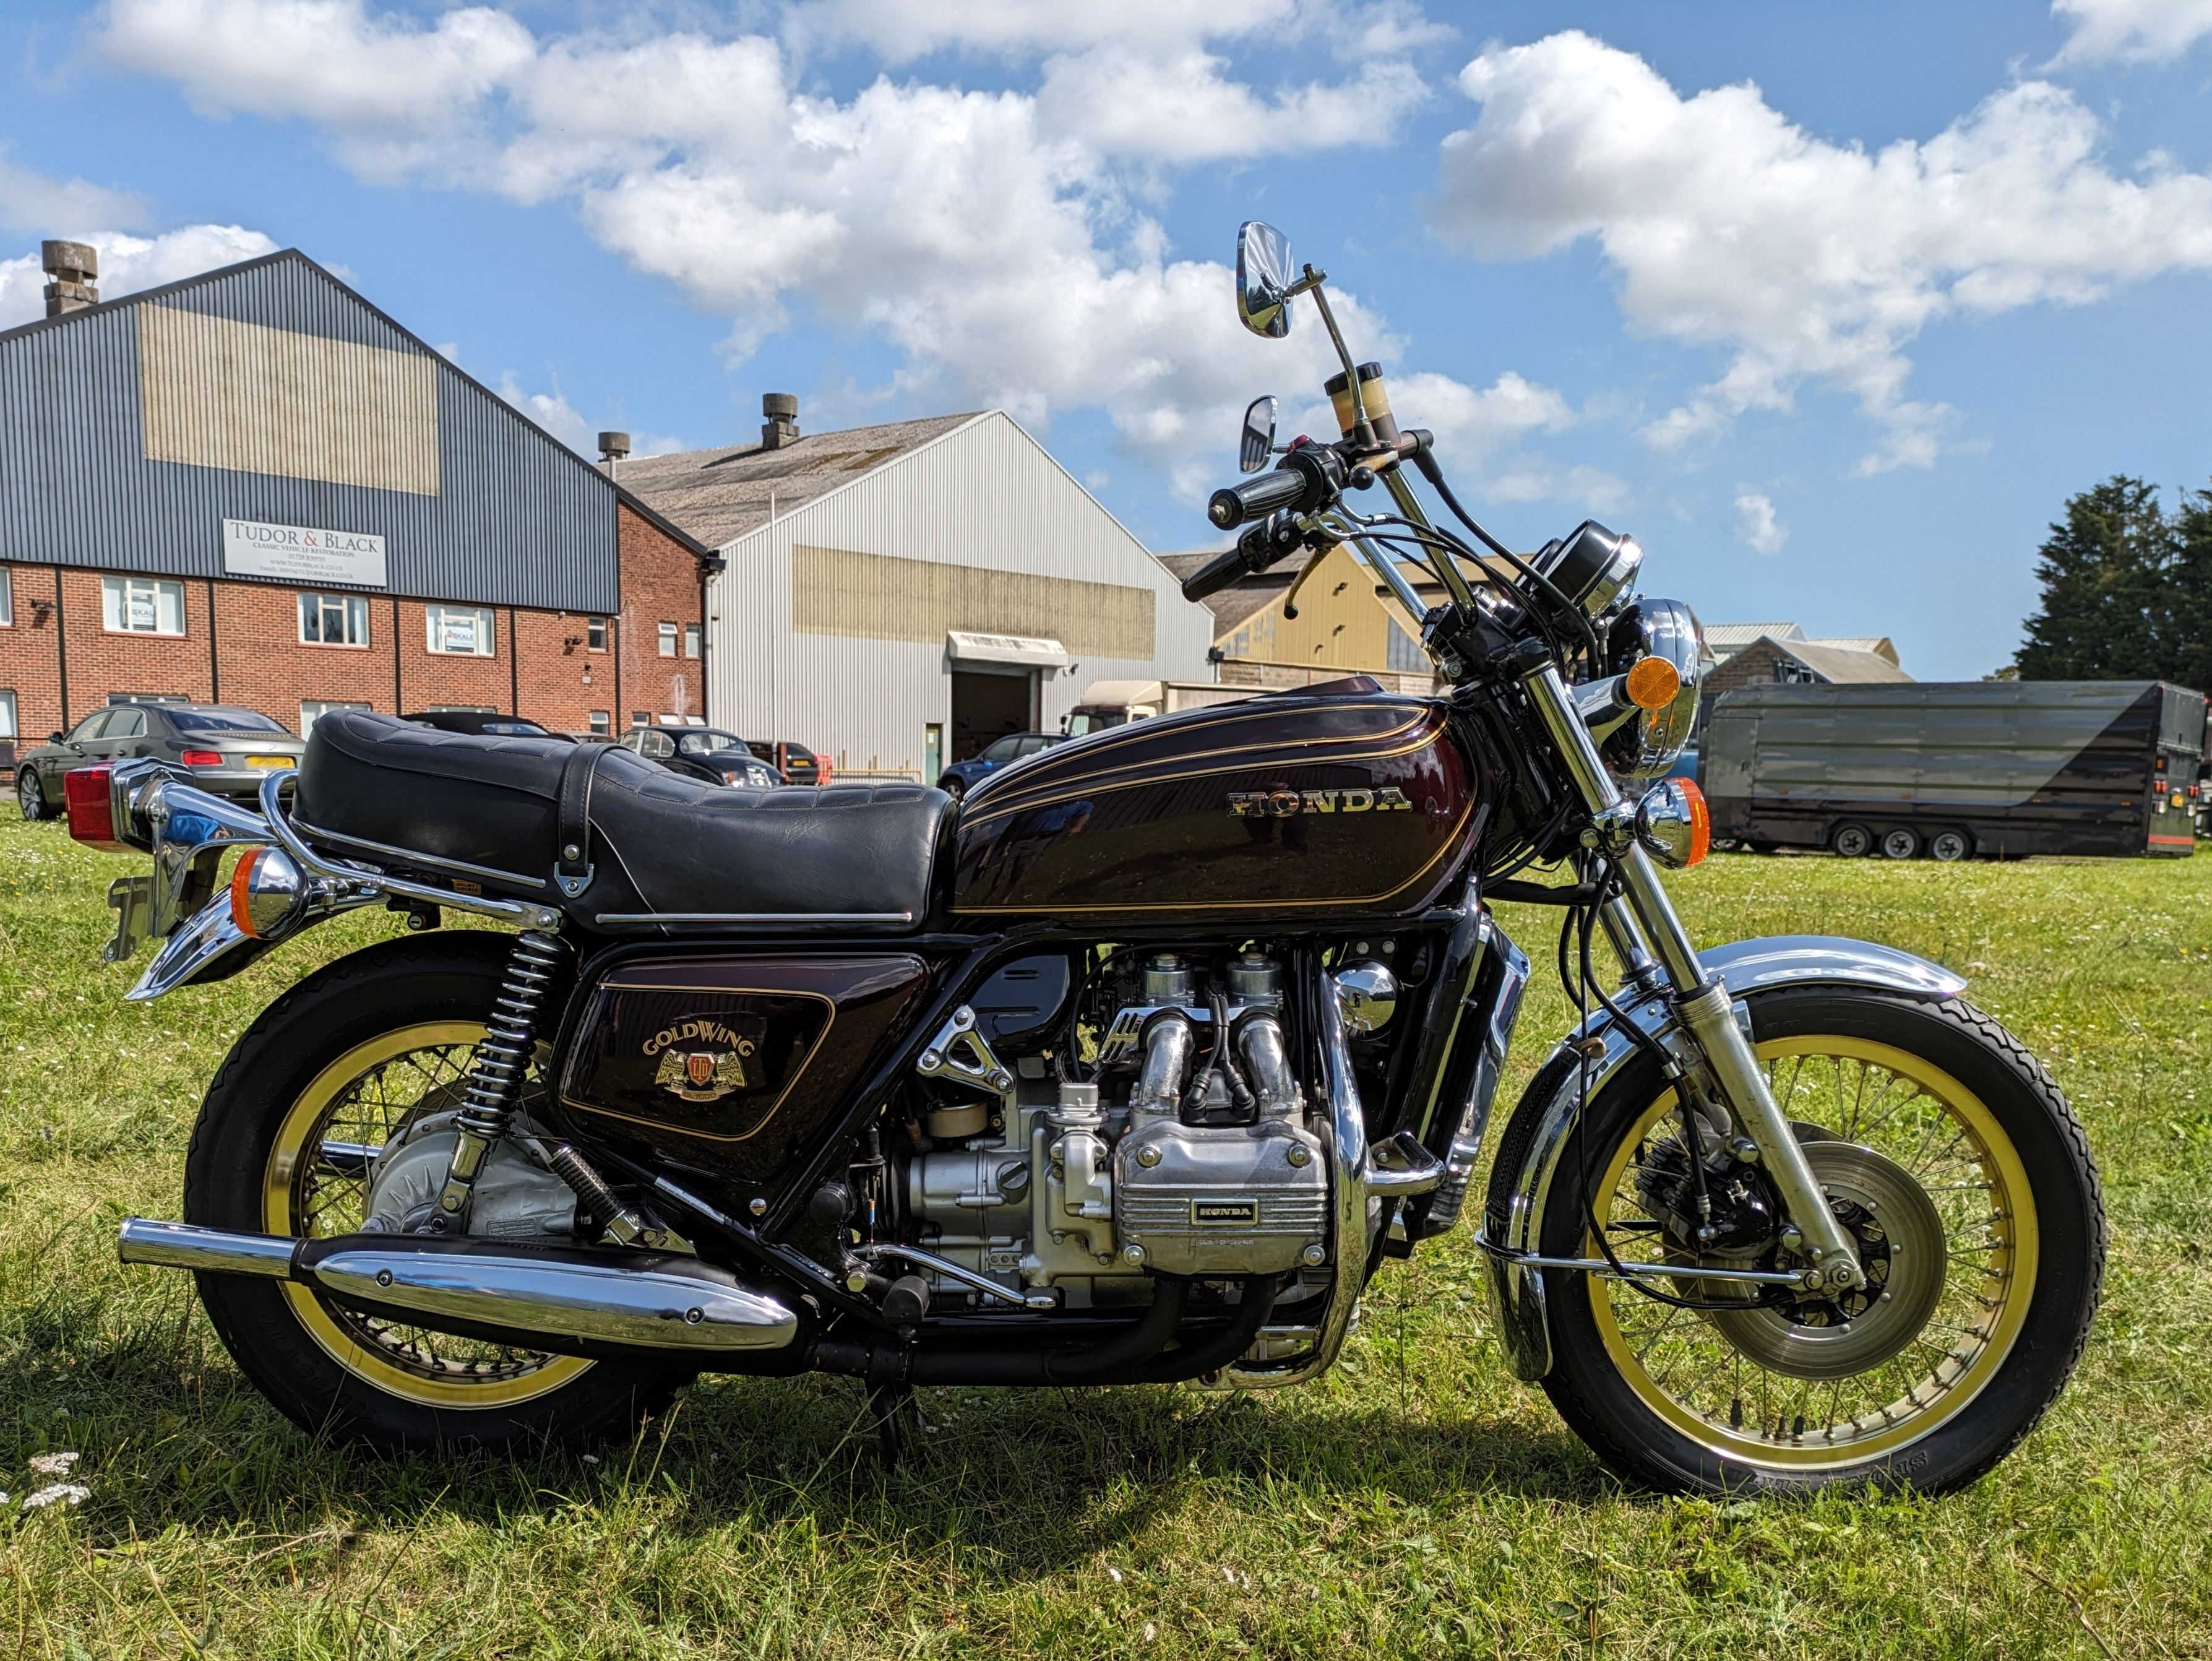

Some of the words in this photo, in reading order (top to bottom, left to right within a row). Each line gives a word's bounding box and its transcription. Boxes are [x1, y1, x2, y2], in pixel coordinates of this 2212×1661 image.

[231, 522, 299, 545] TUDOR
[304, 530, 319, 547] &
[325, 532, 378, 553] BLACK
[253, 542, 280, 550] CLASSIC
[311, 548, 355, 557] RESTORATION
[1227, 787, 1413, 818] HONDA
[1199, 1208, 1251, 1216] HONDA
